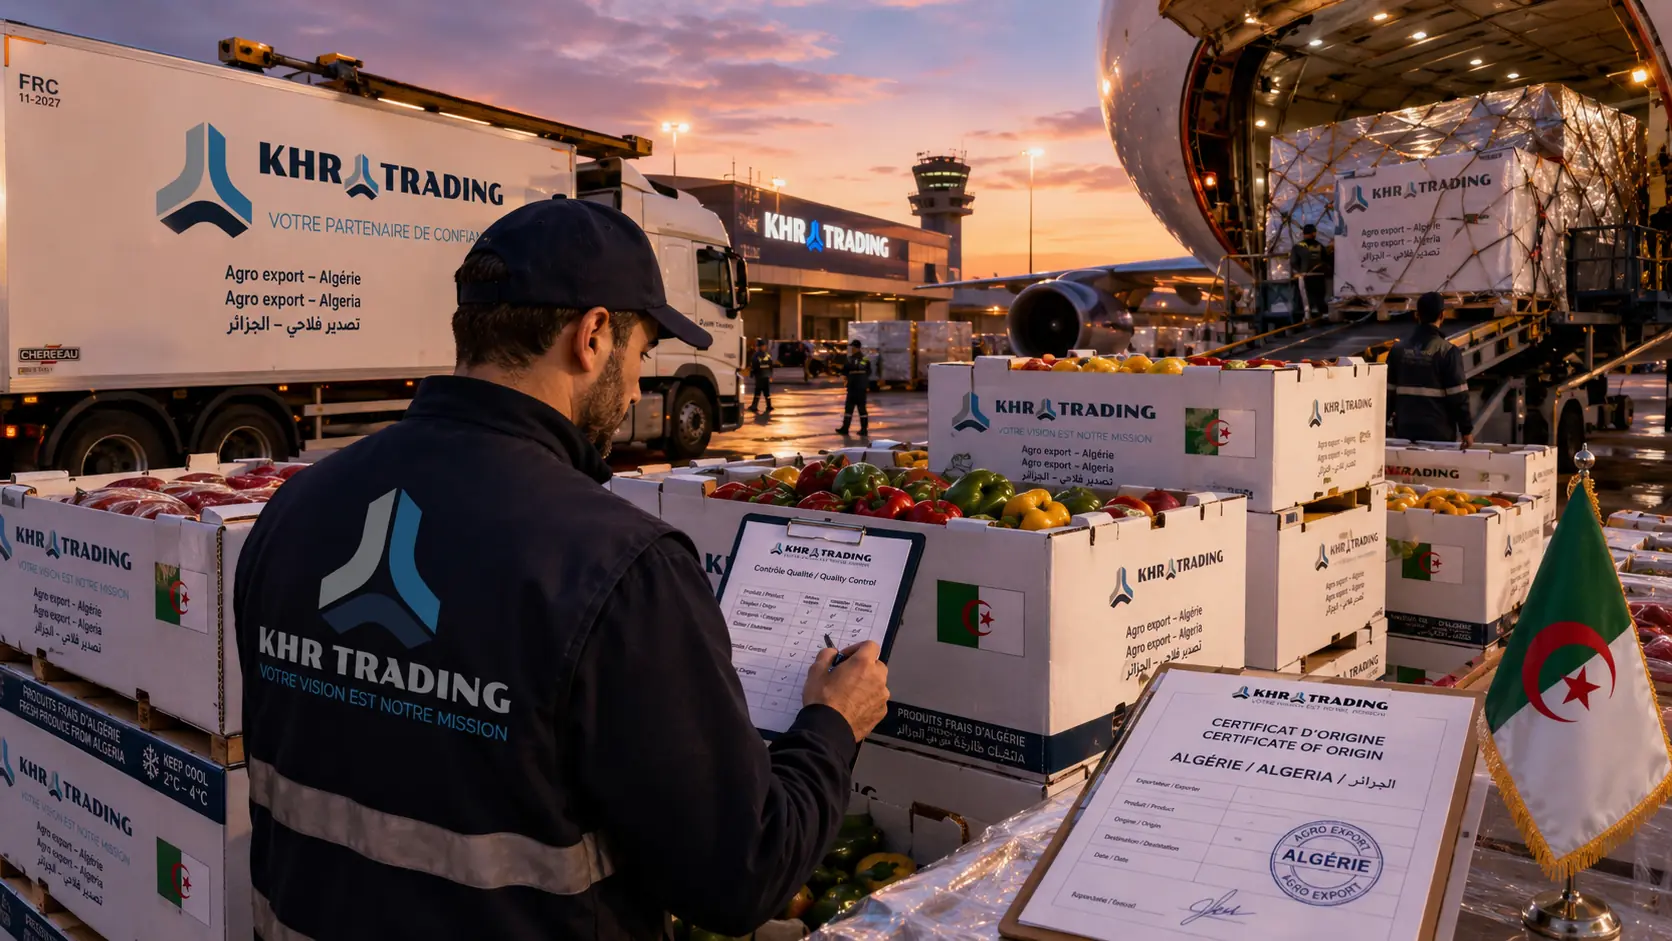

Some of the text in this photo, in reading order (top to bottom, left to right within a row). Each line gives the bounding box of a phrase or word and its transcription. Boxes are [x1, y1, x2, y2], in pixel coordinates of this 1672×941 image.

[19, 73, 59, 95] FRC
[19, 93, 61, 108] 11-2027
[259, 141, 504, 206] KHR TRADING
[1372, 174, 1491, 200] KHR TRADING
[268, 212, 321, 232] VOTRE
[325, 216, 410, 240] PARTENAIRE
[414, 224, 430, 241] DE
[764, 212, 806, 243] KHR
[823, 224, 889, 258] TRADING
[225, 264, 361, 287] Agro export Algérie
[225, 290, 361, 311] Agro export Algeria
[226, 314, 360, 338] تصدير فلاحي الجزائر
[996, 400, 1156, 419] KHR TRADING
[1324, 401, 1339, 413] KHR
[998, 426, 1152, 443] VOTRE VISION EST NOTRE MISSION
[1022, 445, 1114, 460] Agro export Algérie
[1022, 458, 1114, 473] Agro export Algeria
[16, 526, 132, 570] KHR TRADING
[785, 544, 809, 554] KHR
[821, 549, 872, 562] TRADING
[754, 564, 785, 575] Contrôle
[848, 577, 877, 586] Control
[1138, 550, 1223, 583] KHR TRADING
[33, 587, 48, 602] Agro
[50, 594, 70, 608] export
[33, 604, 49, 618] Agro
[1126, 604, 1203, 639] Agro export Algérie
[1126, 623, 1203, 659] Agro export Algeria
[259, 626, 512, 714] KHR TRADING
[259, 663, 508, 742] VOTRE VISION EST NOTRE MISSION
[1253, 689, 1290, 700] KHR
[1309, 694, 1388, 710] TRADING
[897, 708, 942, 727] PRODUITS
[945, 718, 973, 734] FRAIS
[975, 726, 1026, 748] D'ALGÉRIE
[1211, 717, 1298, 737] CERTIFICAT
[1202, 730, 1384, 761] CERTIFICATE OF ORIGIN
[164, 753, 209, 787] KEEP COOL
[1170, 751, 1347, 785] ALGÉRIE / ALGERIA /
[20, 756, 132, 837] KHR TRADING
[1294, 826, 1371, 851] AGRO EXPORT
[1093, 852, 1129, 863] Date Date
[1282, 848, 1372, 873] ALGÉRIE
[1281, 874, 1362, 900] AGRO EXPORT
